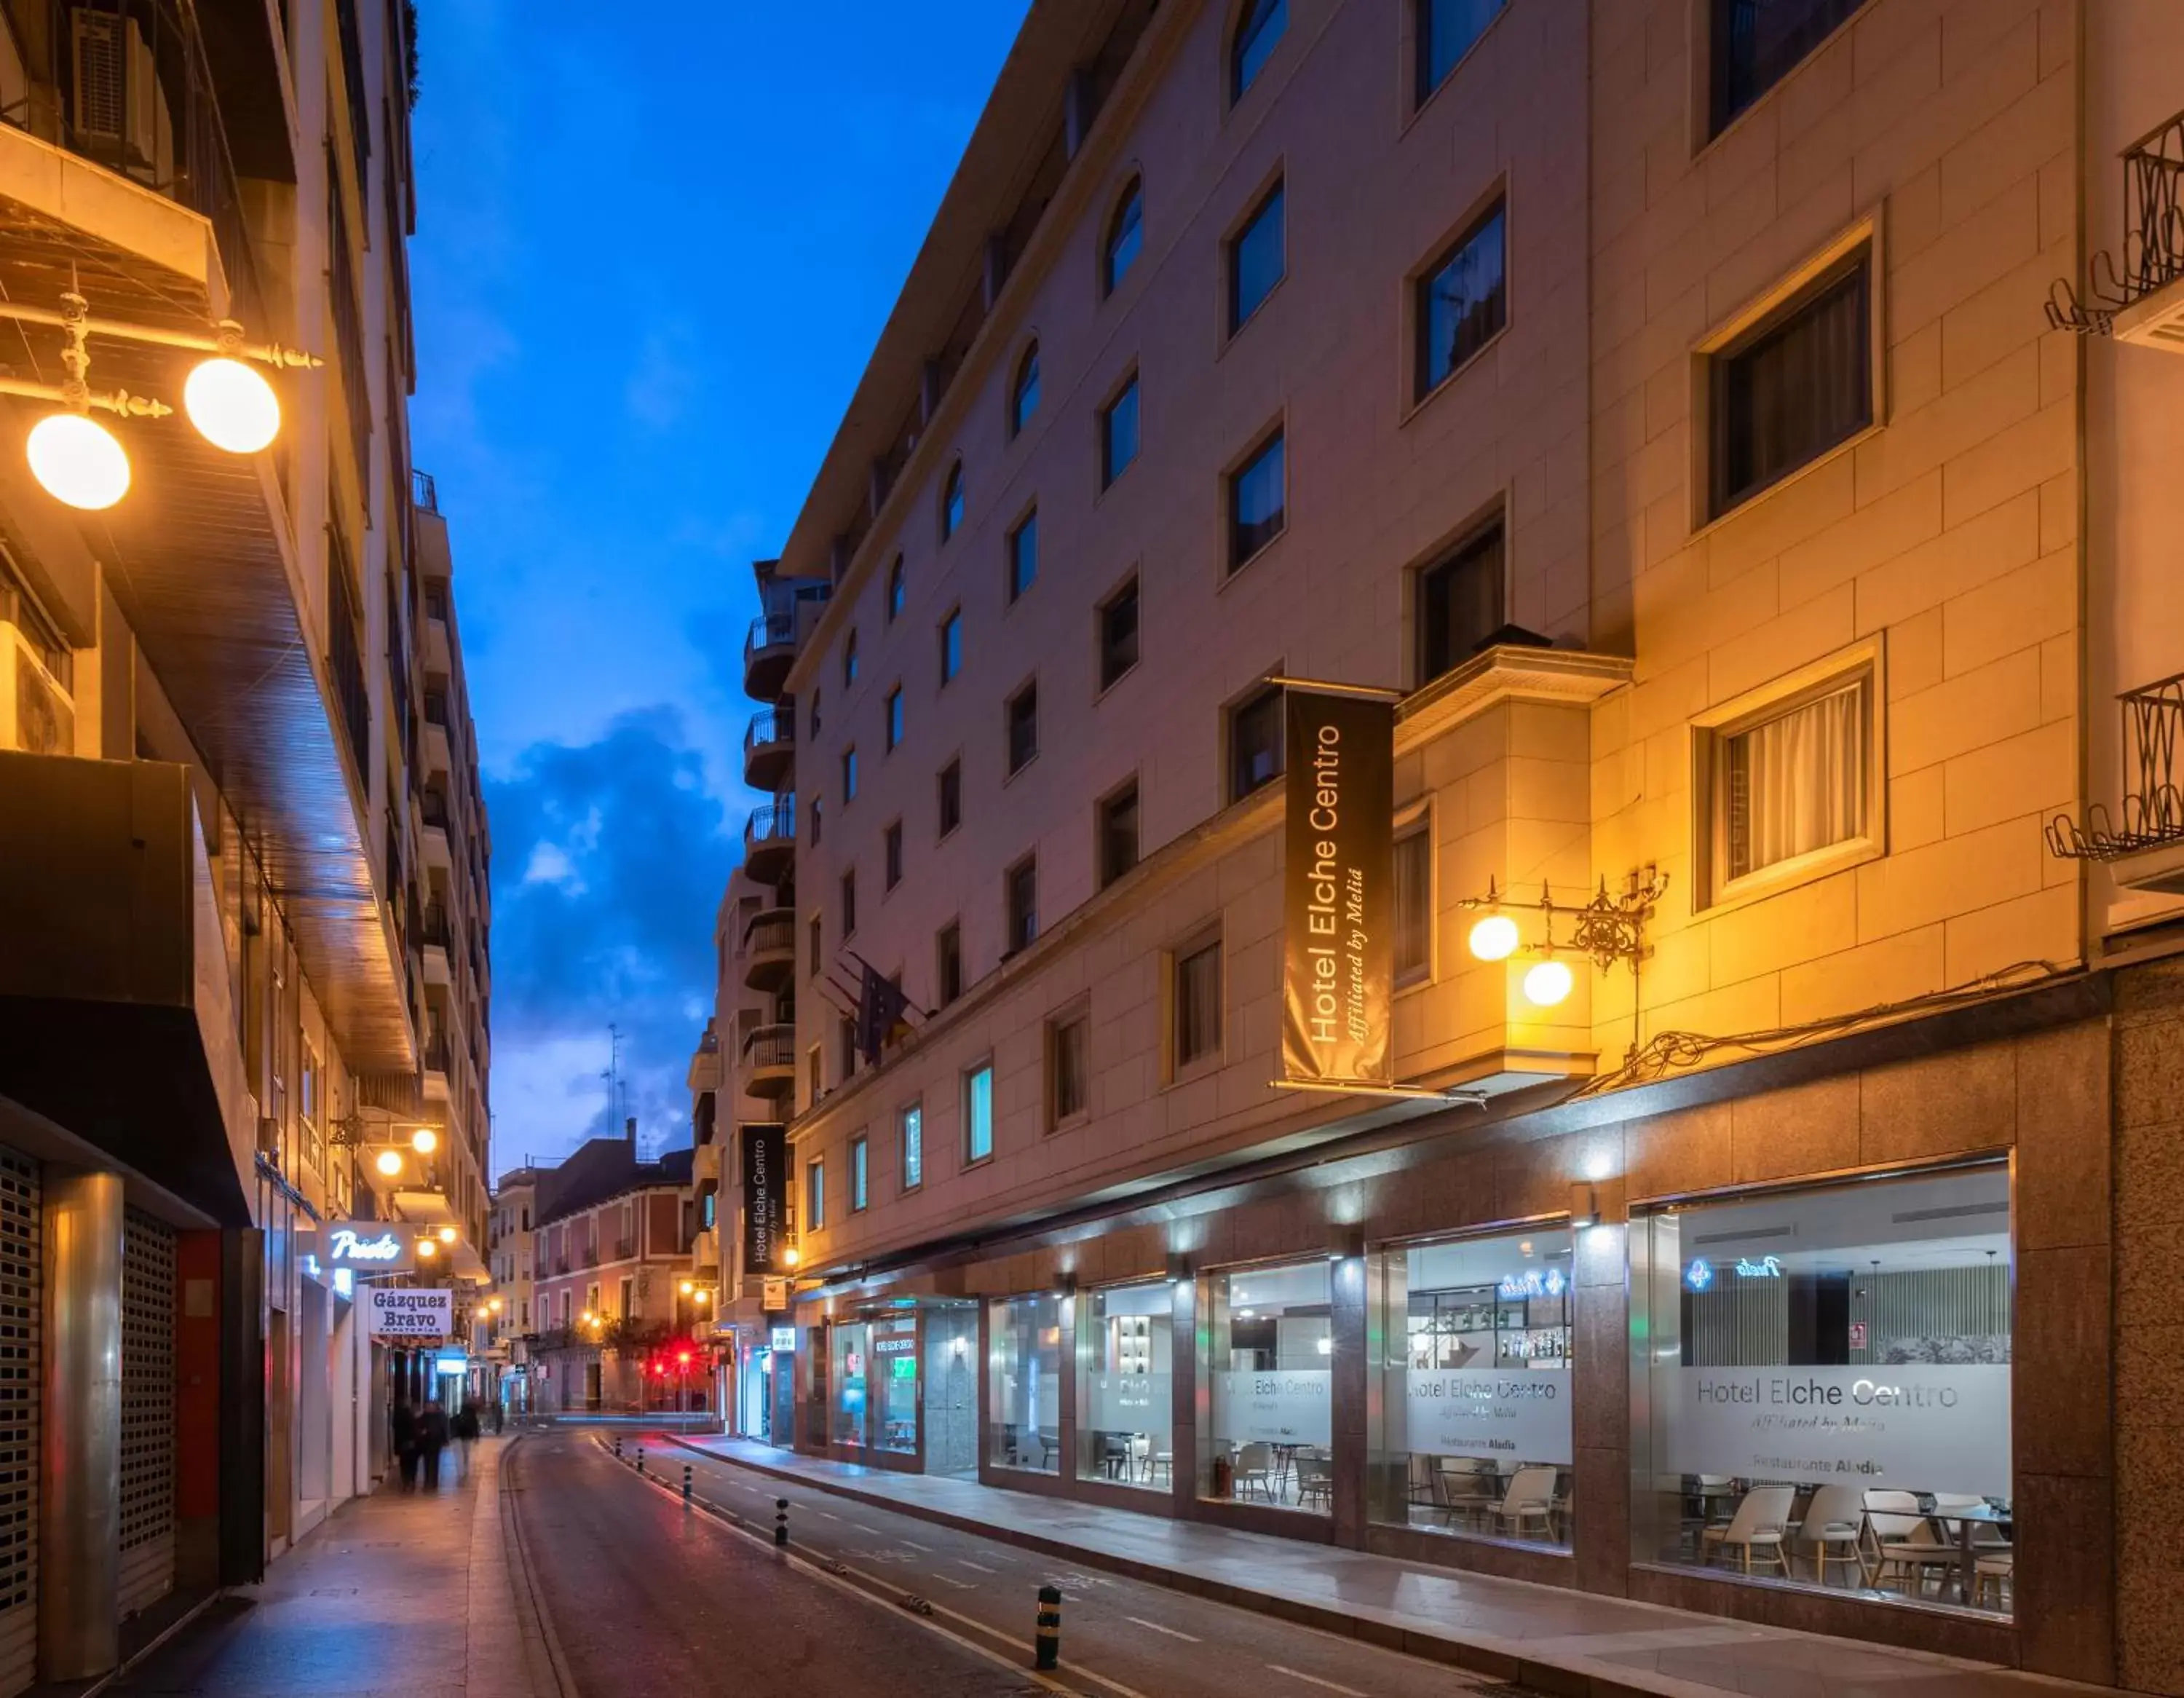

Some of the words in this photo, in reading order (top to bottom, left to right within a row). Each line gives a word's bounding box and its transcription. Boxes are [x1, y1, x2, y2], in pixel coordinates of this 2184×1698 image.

[1310, 725, 1340, 831] Centro
[1307, 840, 1337, 935] Elche
[1347, 929, 1367, 950] by
[1307, 947, 1337, 1043] Hotel
[1347, 953, 1369, 1047] Affiliated
[753, 1139, 765, 1185] Centro
[753, 1188, 766, 1224] Elche
[755, 1225, 767, 1263] Hotel
[373, 1292, 446, 1311] Gázquez
[384, 1311, 436, 1326] Bravo
[1451, 1378, 1492, 1399] Elche
[1497, 1379, 1556, 1399] Centro
[1698, 1378, 1760, 1404] Hotel
[1771, 1378, 1843, 1405] Elche
[1852, 1379, 1958, 1408] Centro
